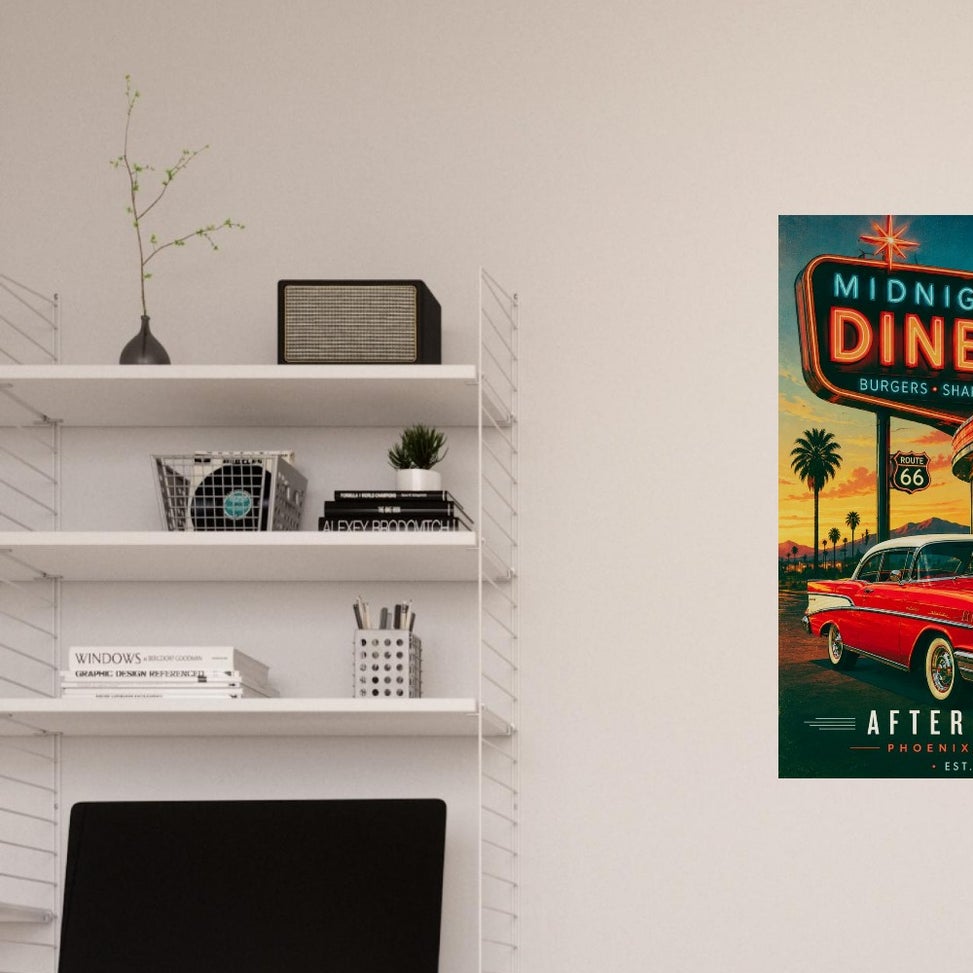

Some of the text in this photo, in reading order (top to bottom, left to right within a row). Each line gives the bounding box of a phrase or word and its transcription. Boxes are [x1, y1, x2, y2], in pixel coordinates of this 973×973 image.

[859, 378, 928, 395] BURGERS
[900, 456, 924, 465] ROUTE
[900, 468, 924, 486] 66
[75, 652, 142, 665] WINDOWS
[115, 670, 147, 678] DESIGN
[867, 709, 963, 735] AFTER
[944, 761, 972, 771] EST.
